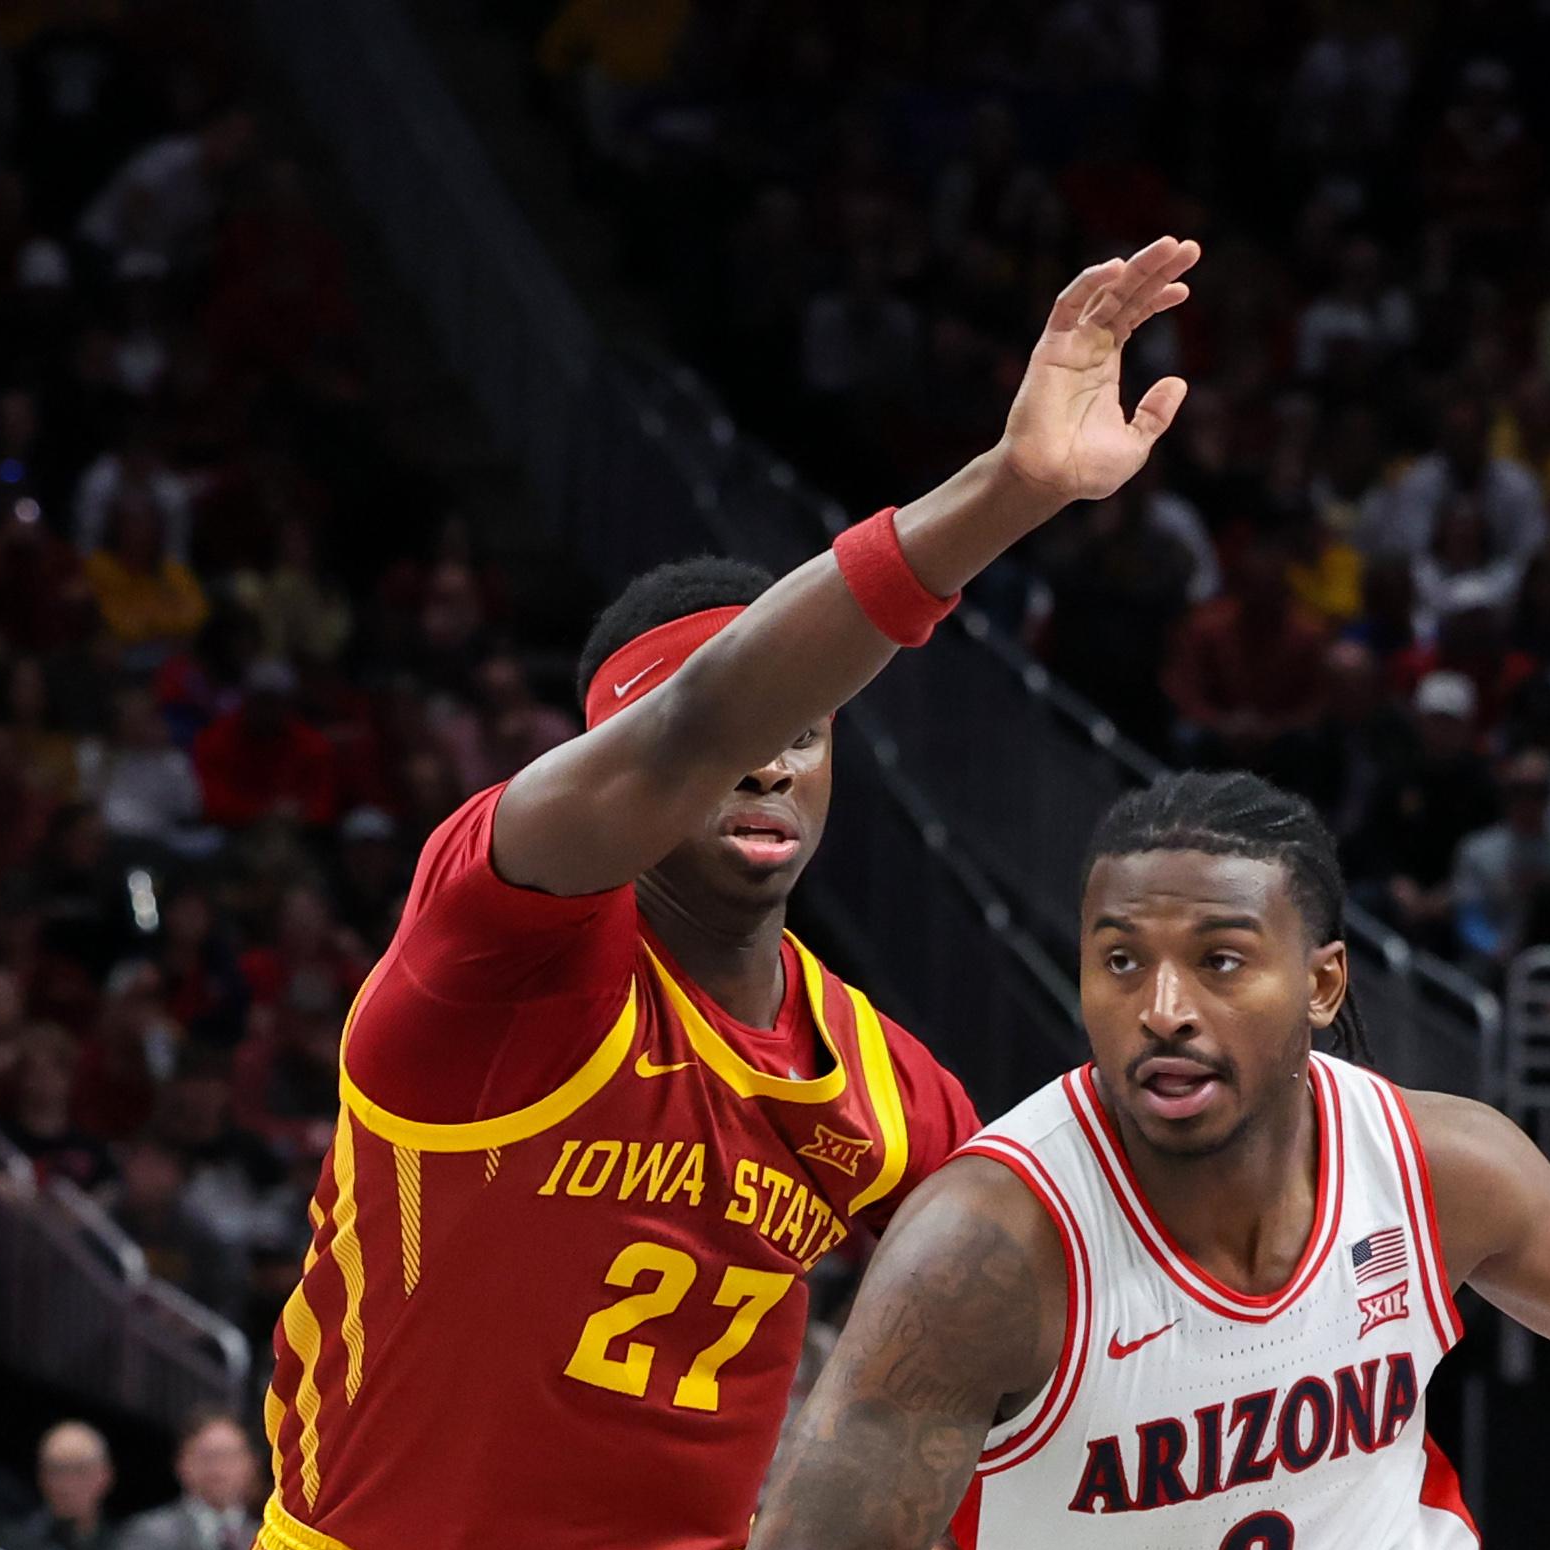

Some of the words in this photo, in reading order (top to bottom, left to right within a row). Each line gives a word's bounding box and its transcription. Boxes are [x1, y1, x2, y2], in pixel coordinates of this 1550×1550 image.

[537, 1140, 706, 1206] IOWA
[724, 1158, 848, 1272] STATE
[563, 1241, 795, 1412] 27
[1357, 1278, 1410, 1340] XII
[1067, 1352, 1419, 1514] ARIZONA
